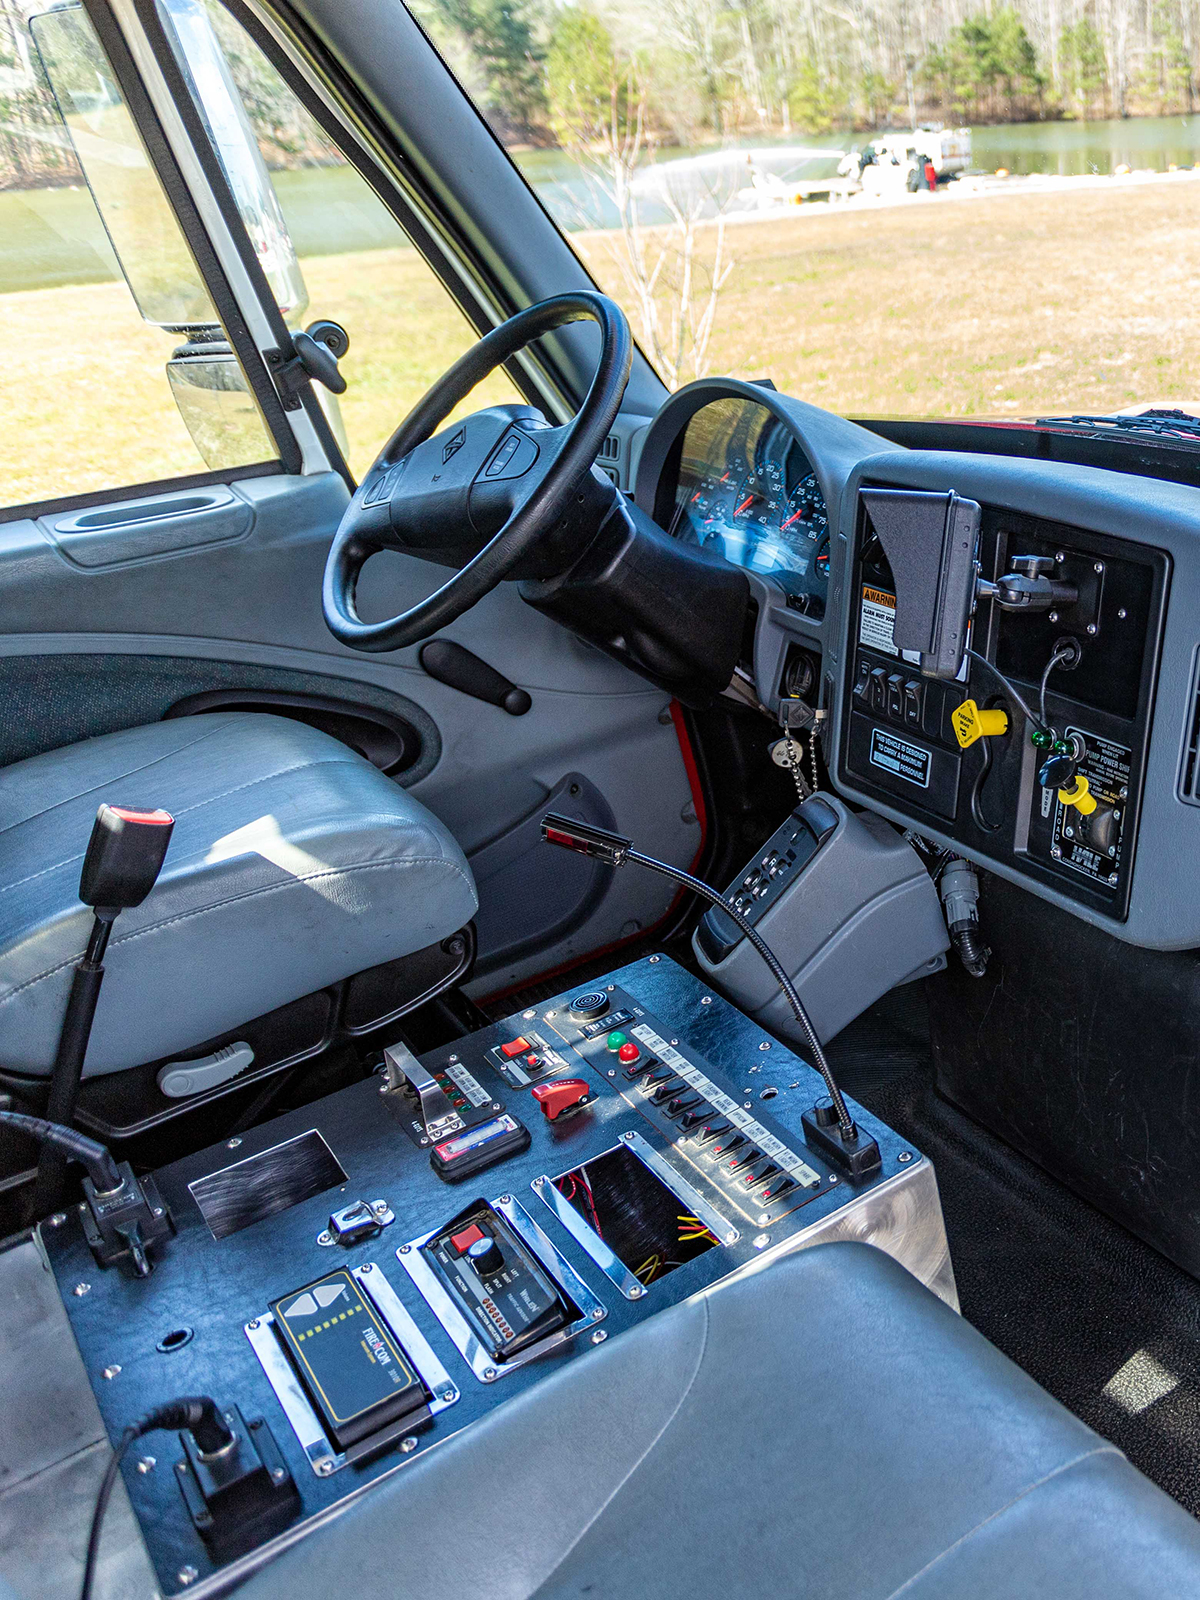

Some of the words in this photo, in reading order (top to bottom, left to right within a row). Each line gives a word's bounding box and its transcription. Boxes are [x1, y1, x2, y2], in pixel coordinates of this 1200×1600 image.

[958, 712, 973, 725] PARKING
[876, 733, 885, 742] THIS
[885, 737, 901, 749] VEHICLE
[905, 746, 926, 761] DESIGNED
[1107, 745, 1124, 755] ENGAGED
[878, 742, 883, 750] TO
[884, 746, 897, 756] CARRY
[900, 753, 922, 768] MAXIMUM
[1085, 749, 1100, 760] PUMP
[1100, 755, 1118, 768] POWER
[900, 763, 924, 780] PERSONNEL
[769, 858, 776, 866] R
[439, 1252, 448, 1264] POWER
[502, 1272, 511, 1284] RIGHT
[511, 1268, 520, 1278] LEFT
[455, 1275, 468, 1292] FUNCTION
[484, 1283, 494, 1295] FLASH
[493, 1278, 502, 1289] SPLIT
[475, 1306, 490, 1325] DIRECTION
[486, 1323, 502, 1343] INDICATOR
[362, 1327, 391, 1365] FIRECOM
